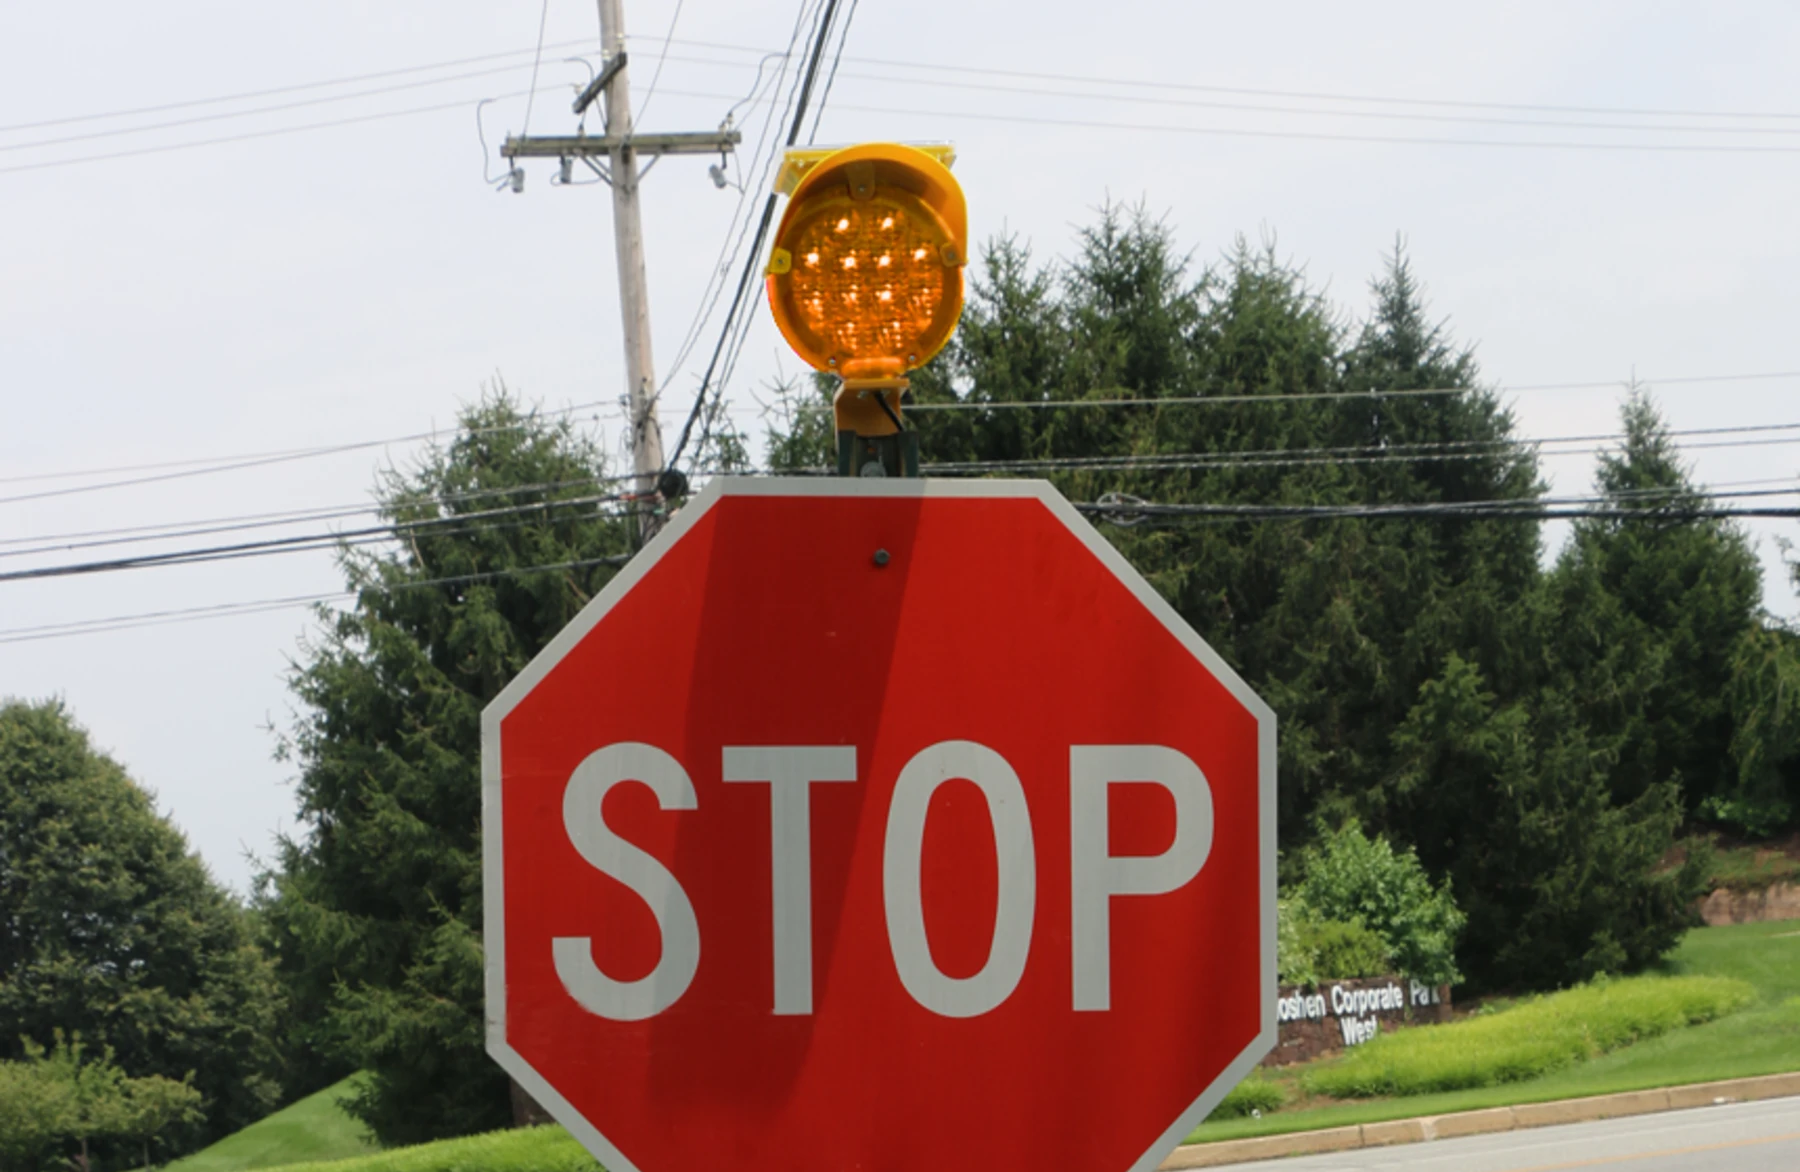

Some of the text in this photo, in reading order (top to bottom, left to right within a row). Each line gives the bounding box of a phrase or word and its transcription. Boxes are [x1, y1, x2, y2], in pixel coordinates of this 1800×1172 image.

[552, 740, 1214, 1021] STOP
[1277, 979, 1441, 1020] oshen Corporate Pak
[1341, 1015, 1378, 1046] West
